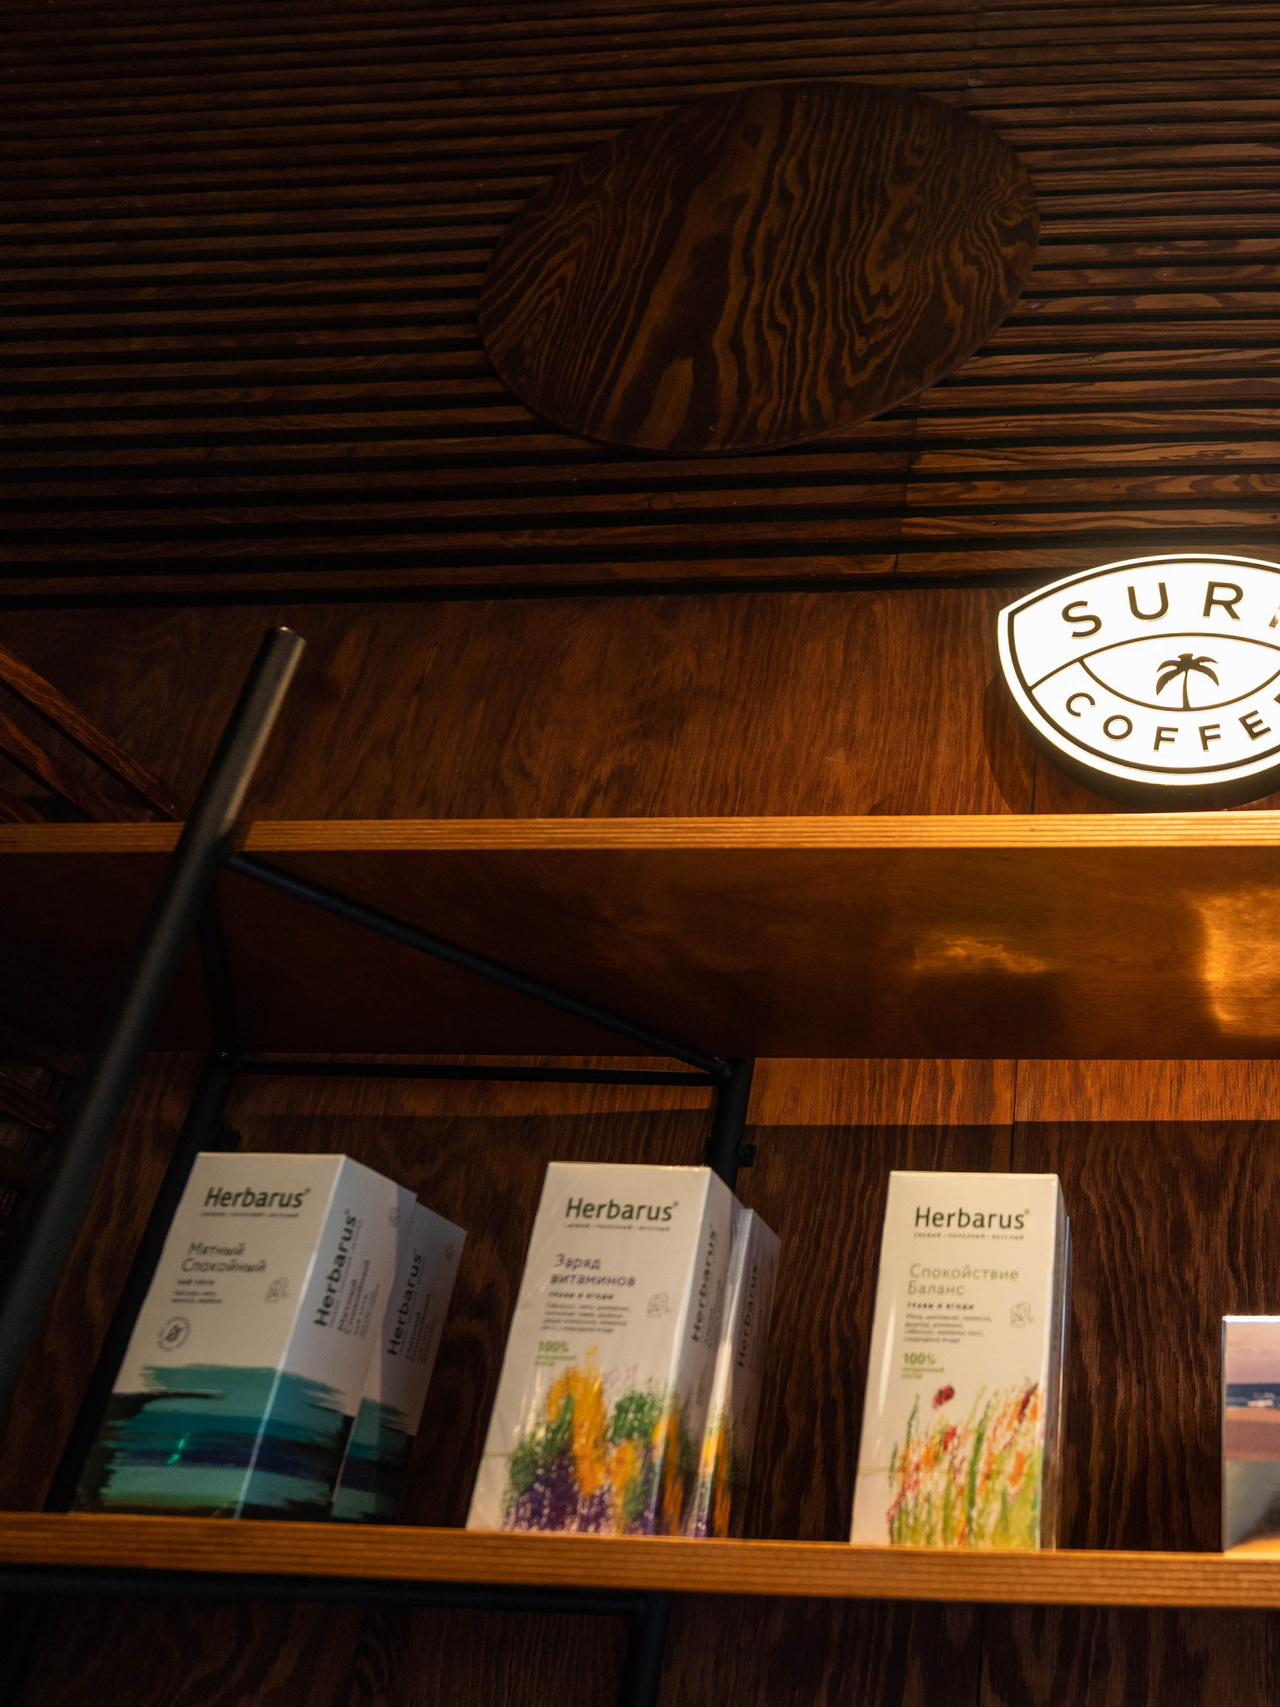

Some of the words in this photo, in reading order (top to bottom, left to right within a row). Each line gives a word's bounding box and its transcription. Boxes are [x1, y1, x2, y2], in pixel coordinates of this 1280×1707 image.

[553, 1252, 602, 1271] Заряд
[908, 1262, 1020, 1281] Спокойствие
[549, 1273, 637, 1288] витаминов
[906, 1279, 966, 1296] Баланс
[903, 1351, 936, 1365] 100%
